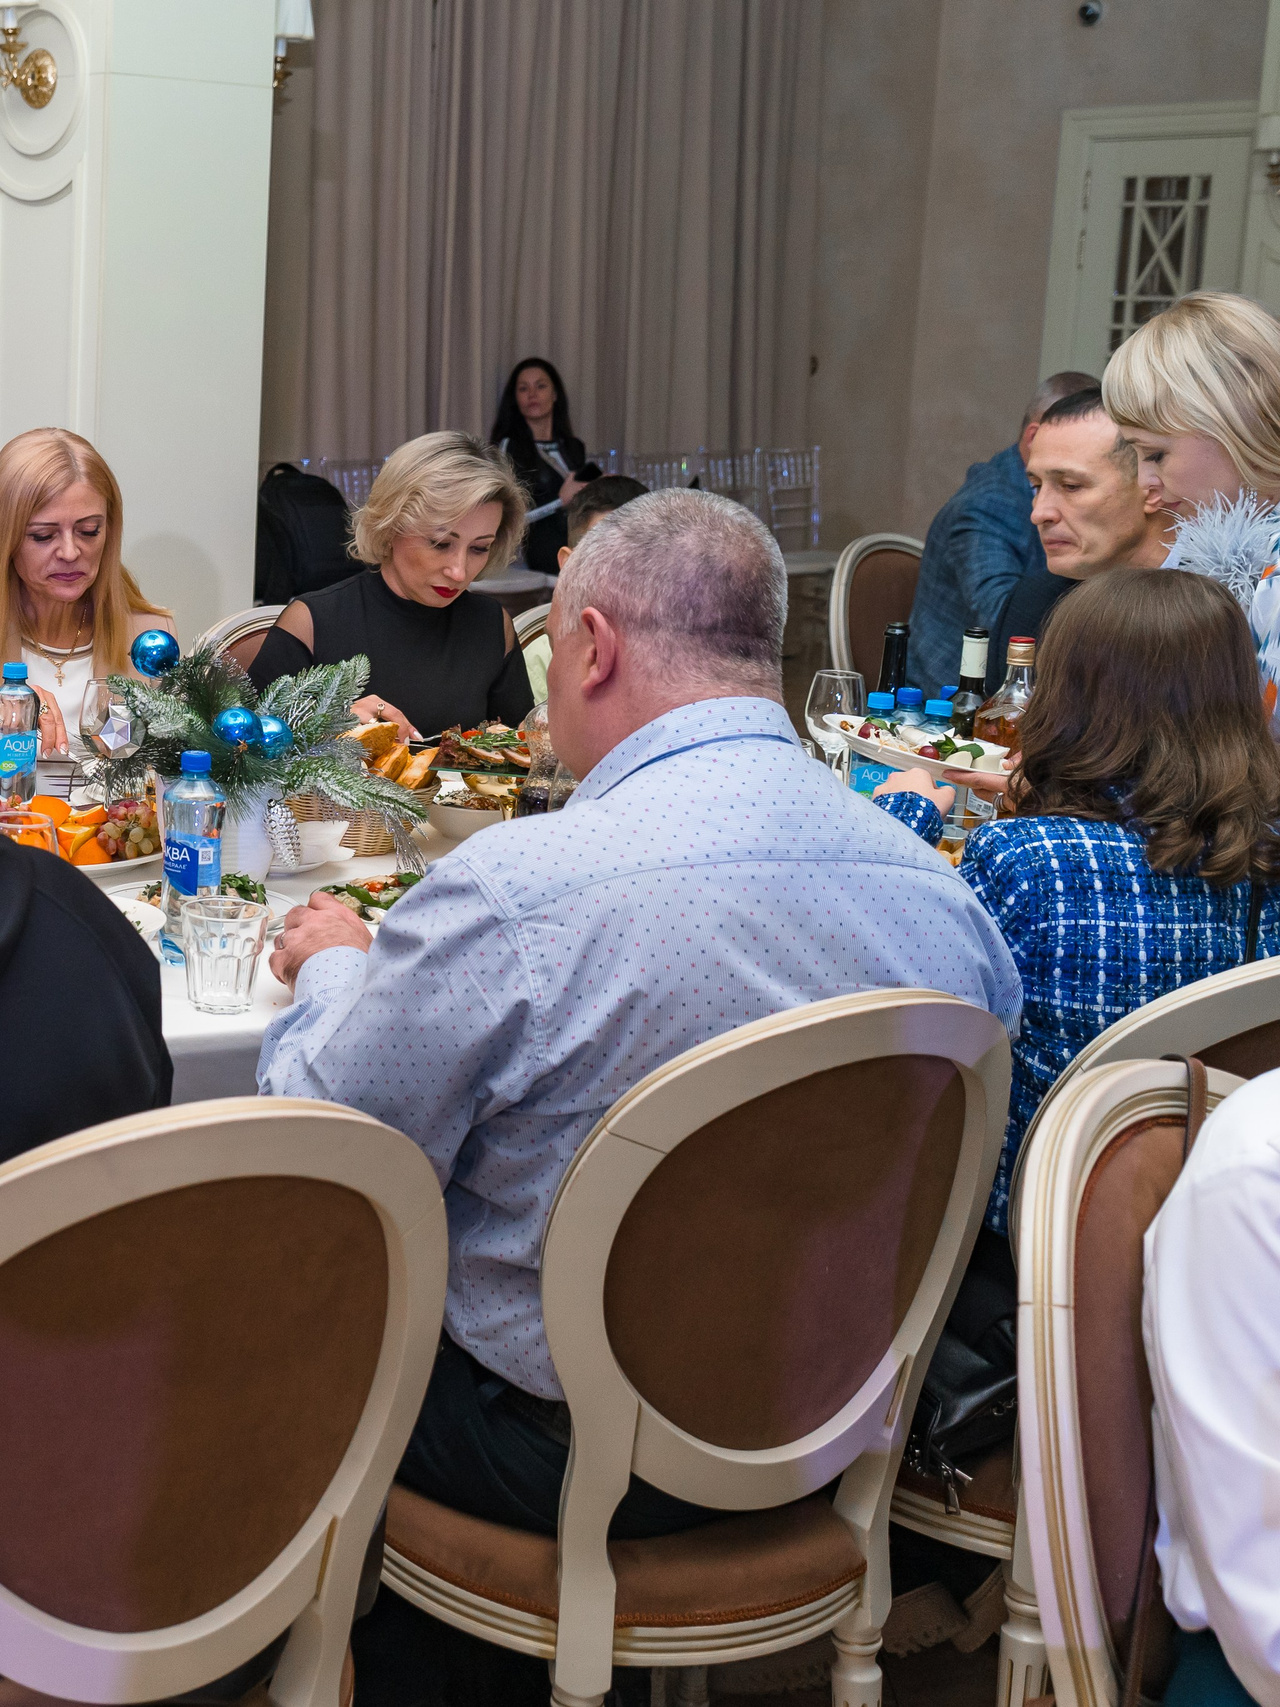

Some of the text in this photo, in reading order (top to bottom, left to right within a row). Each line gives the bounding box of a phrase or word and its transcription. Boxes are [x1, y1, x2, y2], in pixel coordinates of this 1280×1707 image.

[4, 738, 35, 752] AQUA
[862, 768, 894, 783] AQU
[165, 845, 191, 862] КВА
